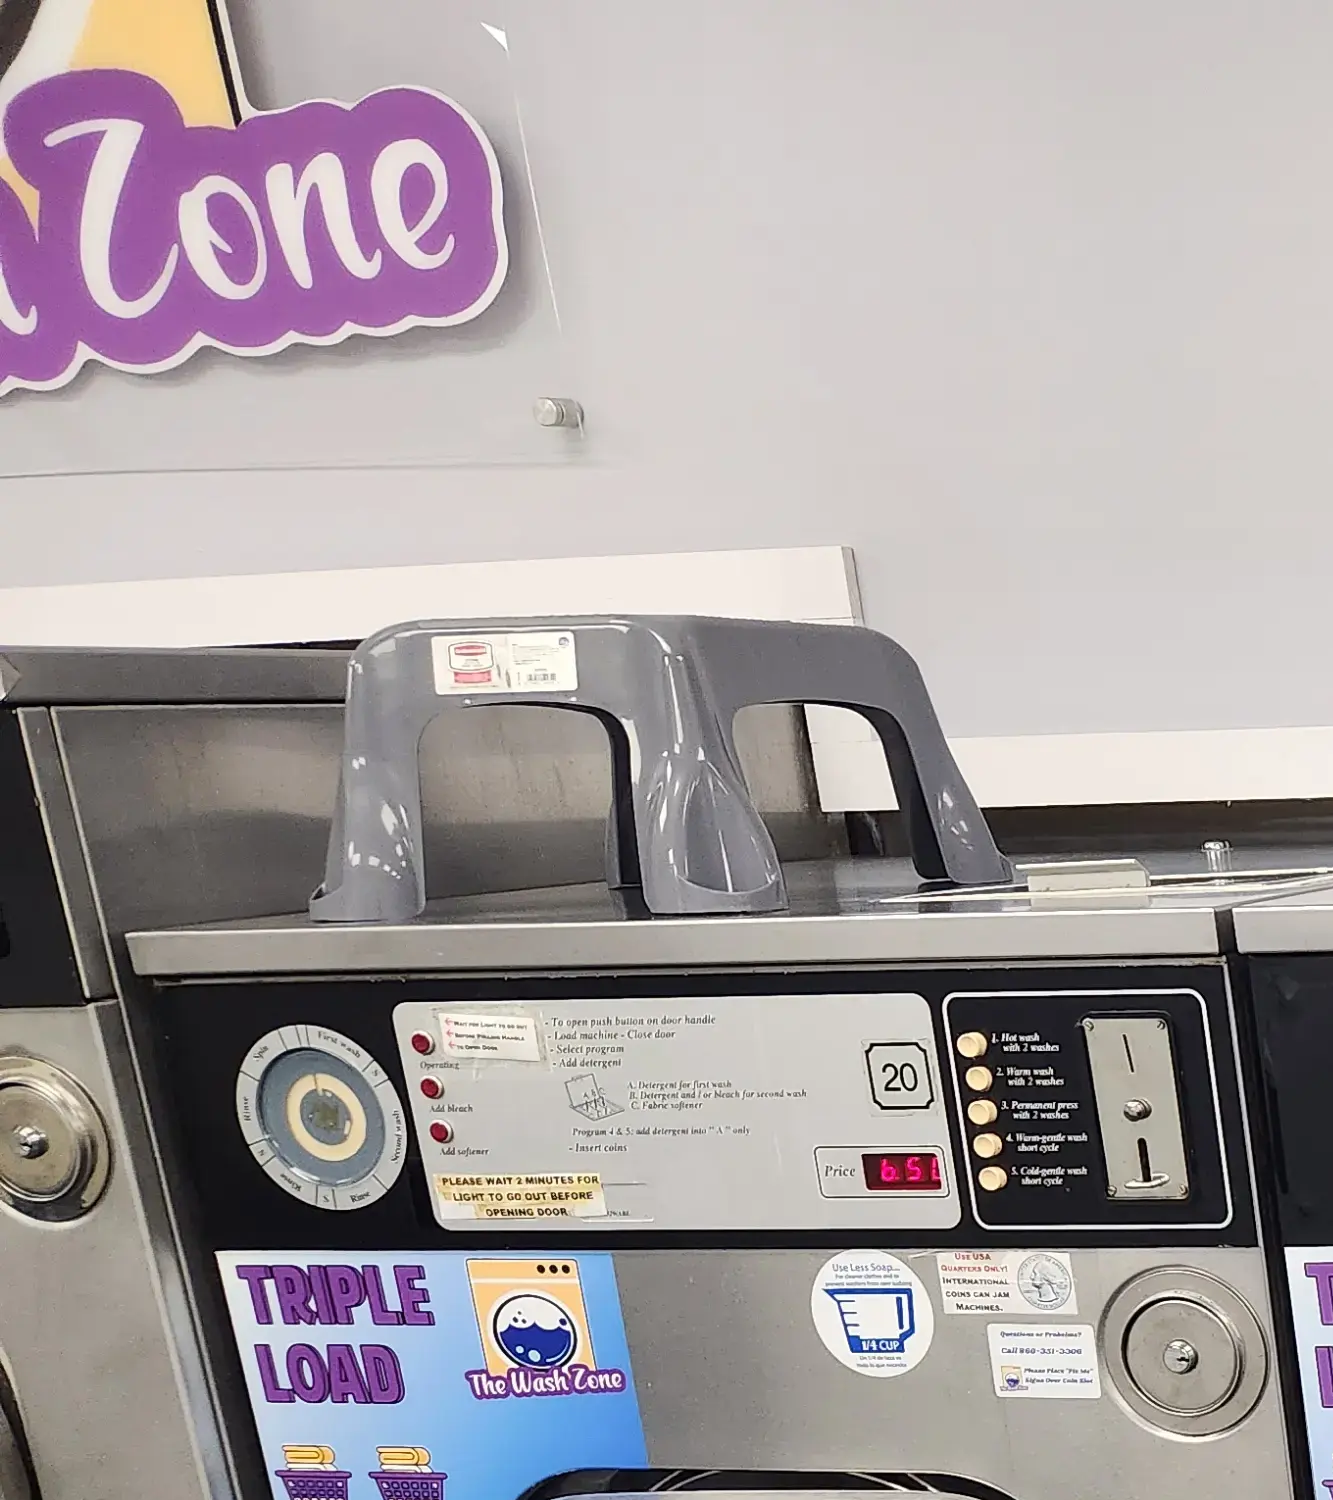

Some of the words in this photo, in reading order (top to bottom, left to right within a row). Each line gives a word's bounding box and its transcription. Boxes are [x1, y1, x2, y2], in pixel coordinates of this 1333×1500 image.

[44, 118, 455, 318] Zone
[552, 1018, 565, 1026] To
[567, 1019, 588, 1028] open
[590, 1017, 612, 1028] push
[615, 1017, 644, 1026] button
[646, 1018, 659, 1026] on
[661, 1016, 682, 1025] door
[684, 1015, 716, 1025] handle
[554, 1030, 576, 1040] Load
[580, 1030, 618, 1040] machine
[627, 1029, 652, 1039] Close
[655, 1029, 676, 1039] door
[557, 1044, 580, 1054] Select
[582, 1045, 624, 1056] program
[559, 1058, 577, 1068] Add
[580, 1058, 621, 1069] detergent
[881, 1062, 918, 1092] 20
[575, 1143, 601, 1152] Insert
[604, 1143, 627, 1152] coins
[824, 1164, 856, 1178] Price
[442, 1176, 482, 1186] PLEASE
[485, 1176, 513, 1185] WAIT
[516, 1176, 522, 1185] 2
[525, 1176, 574, 1185] MINUTES
[577, 1176, 599, 1184] FOR
[453, 1192, 485, 1202] LIGHT
[488, 1192, 503, 1201] TO
[506, 1192, 521, 1201] GO
[525, 1192, 547, 1201] OUT
[550, 1191, 593, 1200] BEFORE
[485, 1208, 534, 1217] OPENING
[537, 1207, 568, 1217] DOOR
[832, 1264, 848, 1272] Use
[235, 1264, 436, 1326] TRIPLE
[862, 1340, 878, 1350] 1/4
[879, 1340, 900, 1350] CUP
[254, 1344, 406, 1404] LOAD
[469, 1373, 507, 1397] The
[511, 1369, 570, 1393] Wash
[571, 1368, 623, 1390] Zone
